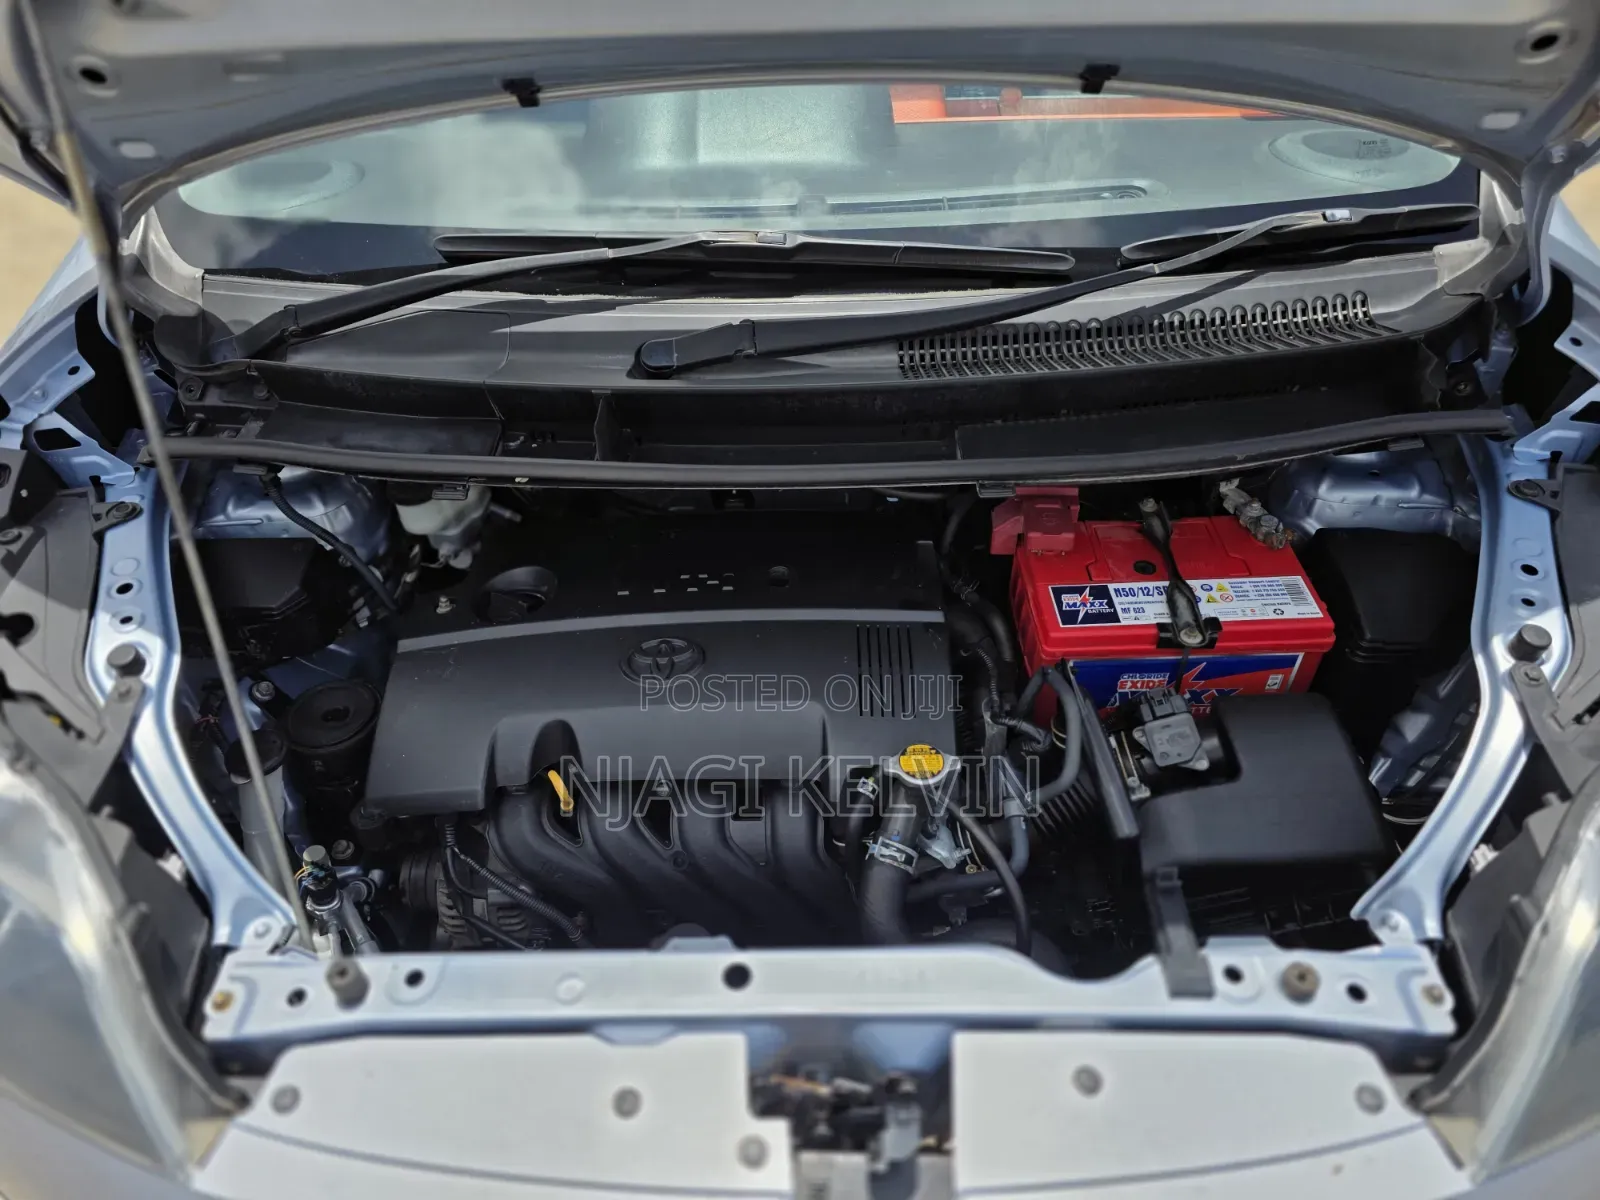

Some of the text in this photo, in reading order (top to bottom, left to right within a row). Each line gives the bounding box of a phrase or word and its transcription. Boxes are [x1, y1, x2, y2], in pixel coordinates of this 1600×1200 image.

[1063, 600, 1108, 609] MAXX
[1120, 672, 1170, 680] CHLORIDE
[1117, 679, 1168, 690] EXIDE
